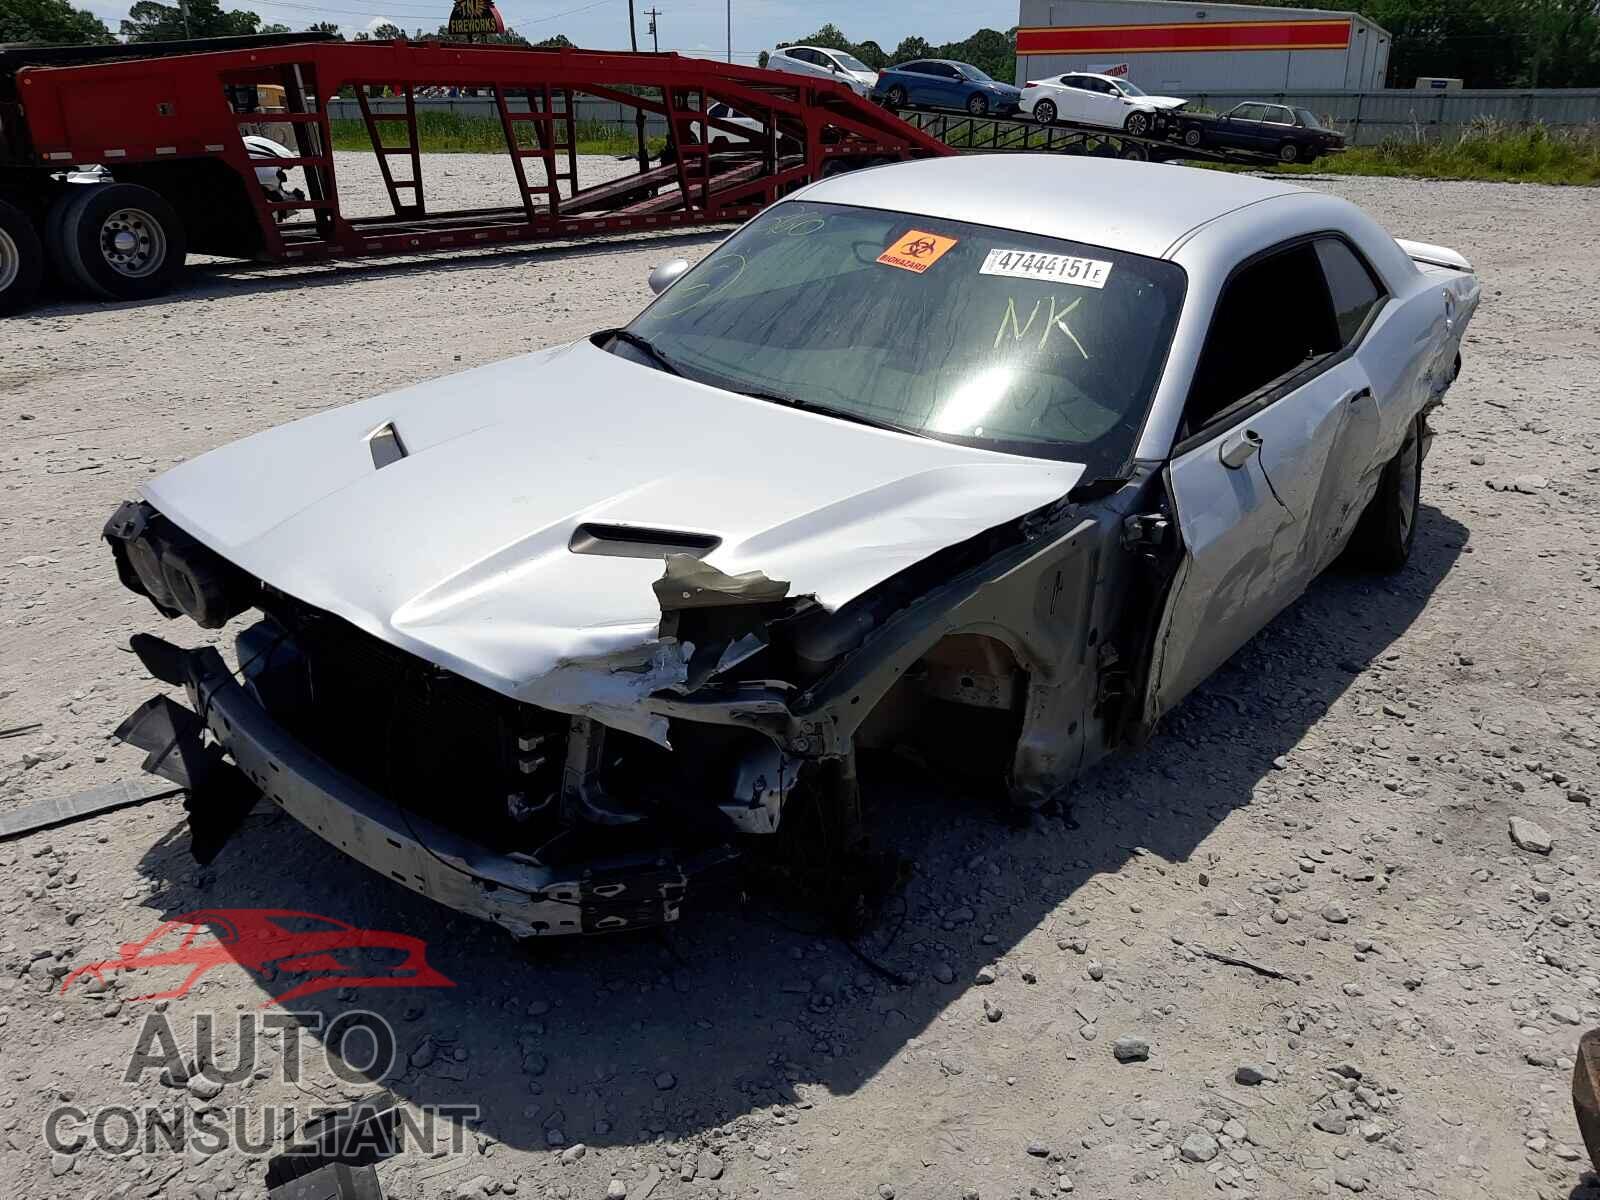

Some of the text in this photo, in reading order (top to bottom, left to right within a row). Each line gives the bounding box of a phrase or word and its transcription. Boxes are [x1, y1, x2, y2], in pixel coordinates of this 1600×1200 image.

[451, 17, 496, 33] FIREWORKS
[879, 254, 928, 271] BIOHAZARD
[998, 252, 1093, 280] 47444151
[993, 296, 1089, 359] NK
